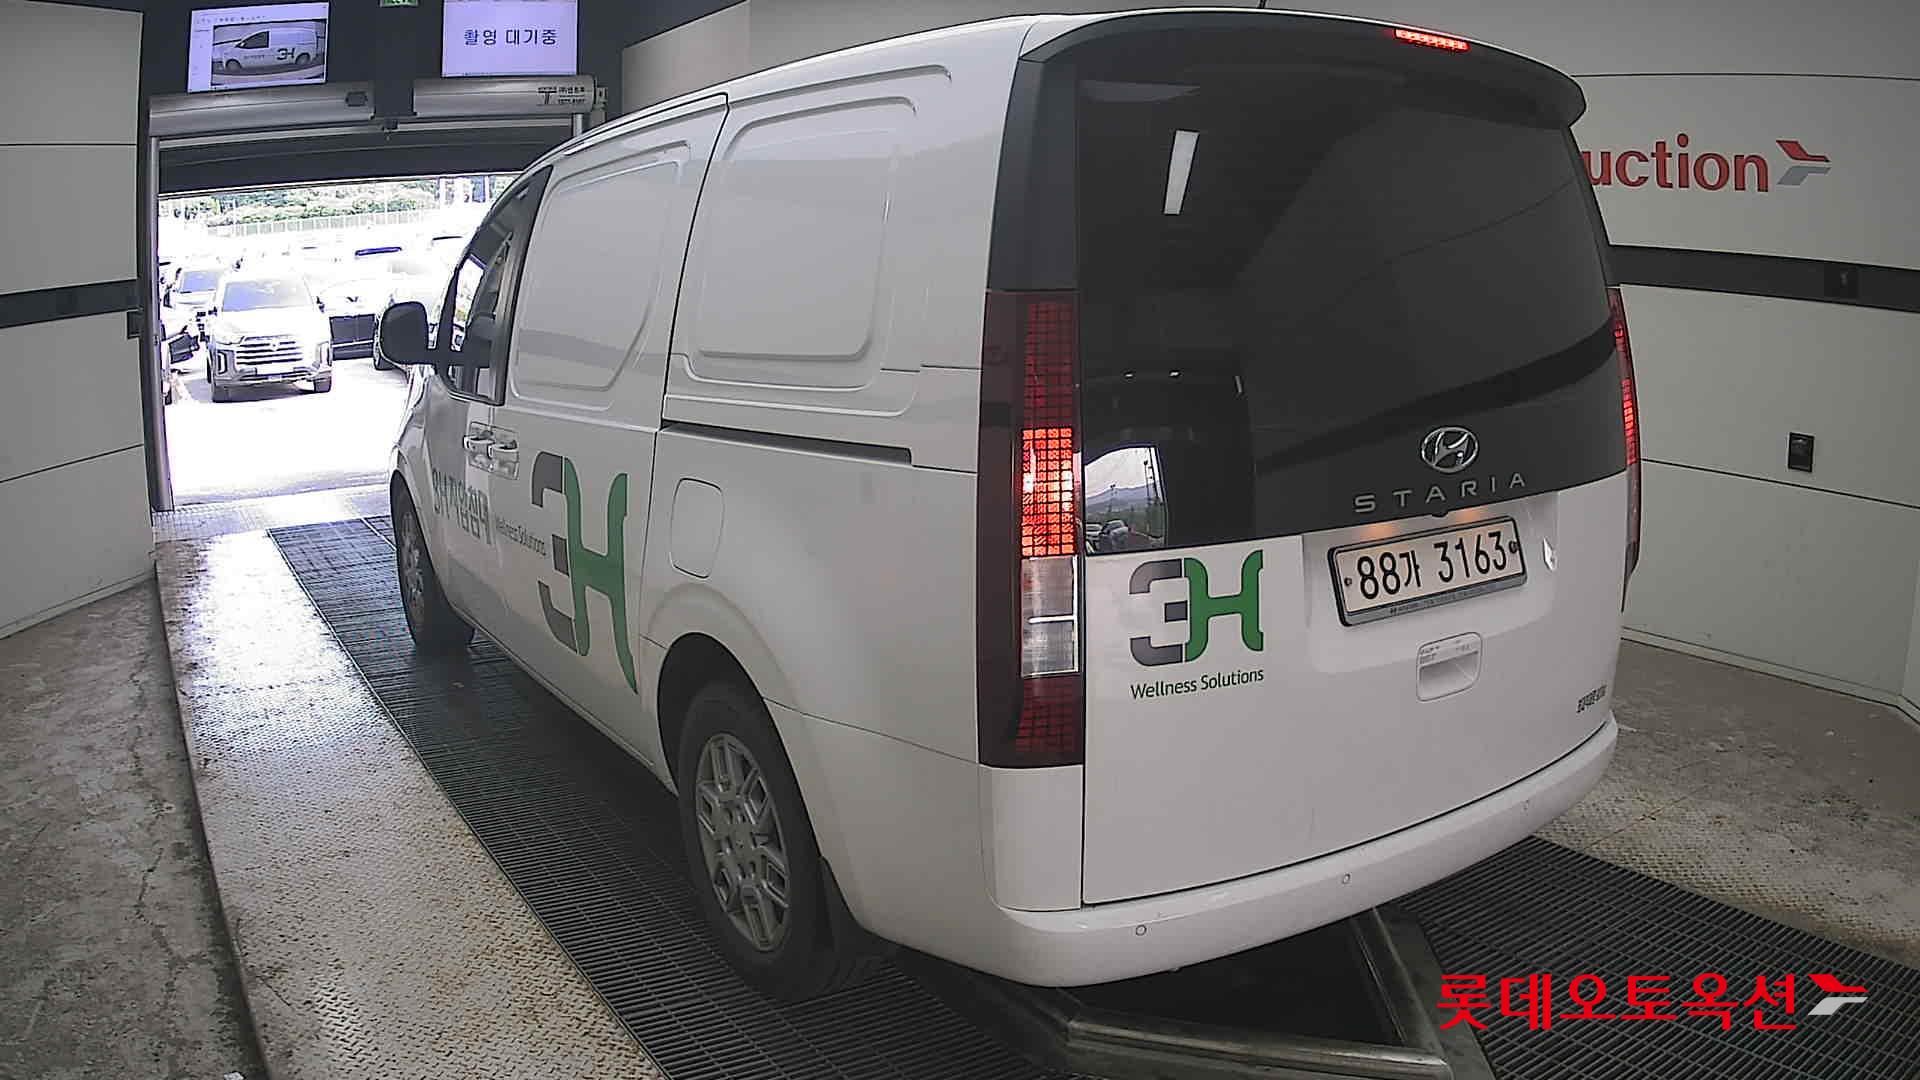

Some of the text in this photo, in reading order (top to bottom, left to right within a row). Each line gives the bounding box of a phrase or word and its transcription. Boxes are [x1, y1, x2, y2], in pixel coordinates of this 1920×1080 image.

[505, 29, 557, 45] 대기중
[1354, 473, 1526, 513] STARIA
[1356, 549, 1422, 600] 88가
[1433, 530, 1508, 583] 3163
[1131, 668, 1265, 700] Wellness Solutions
